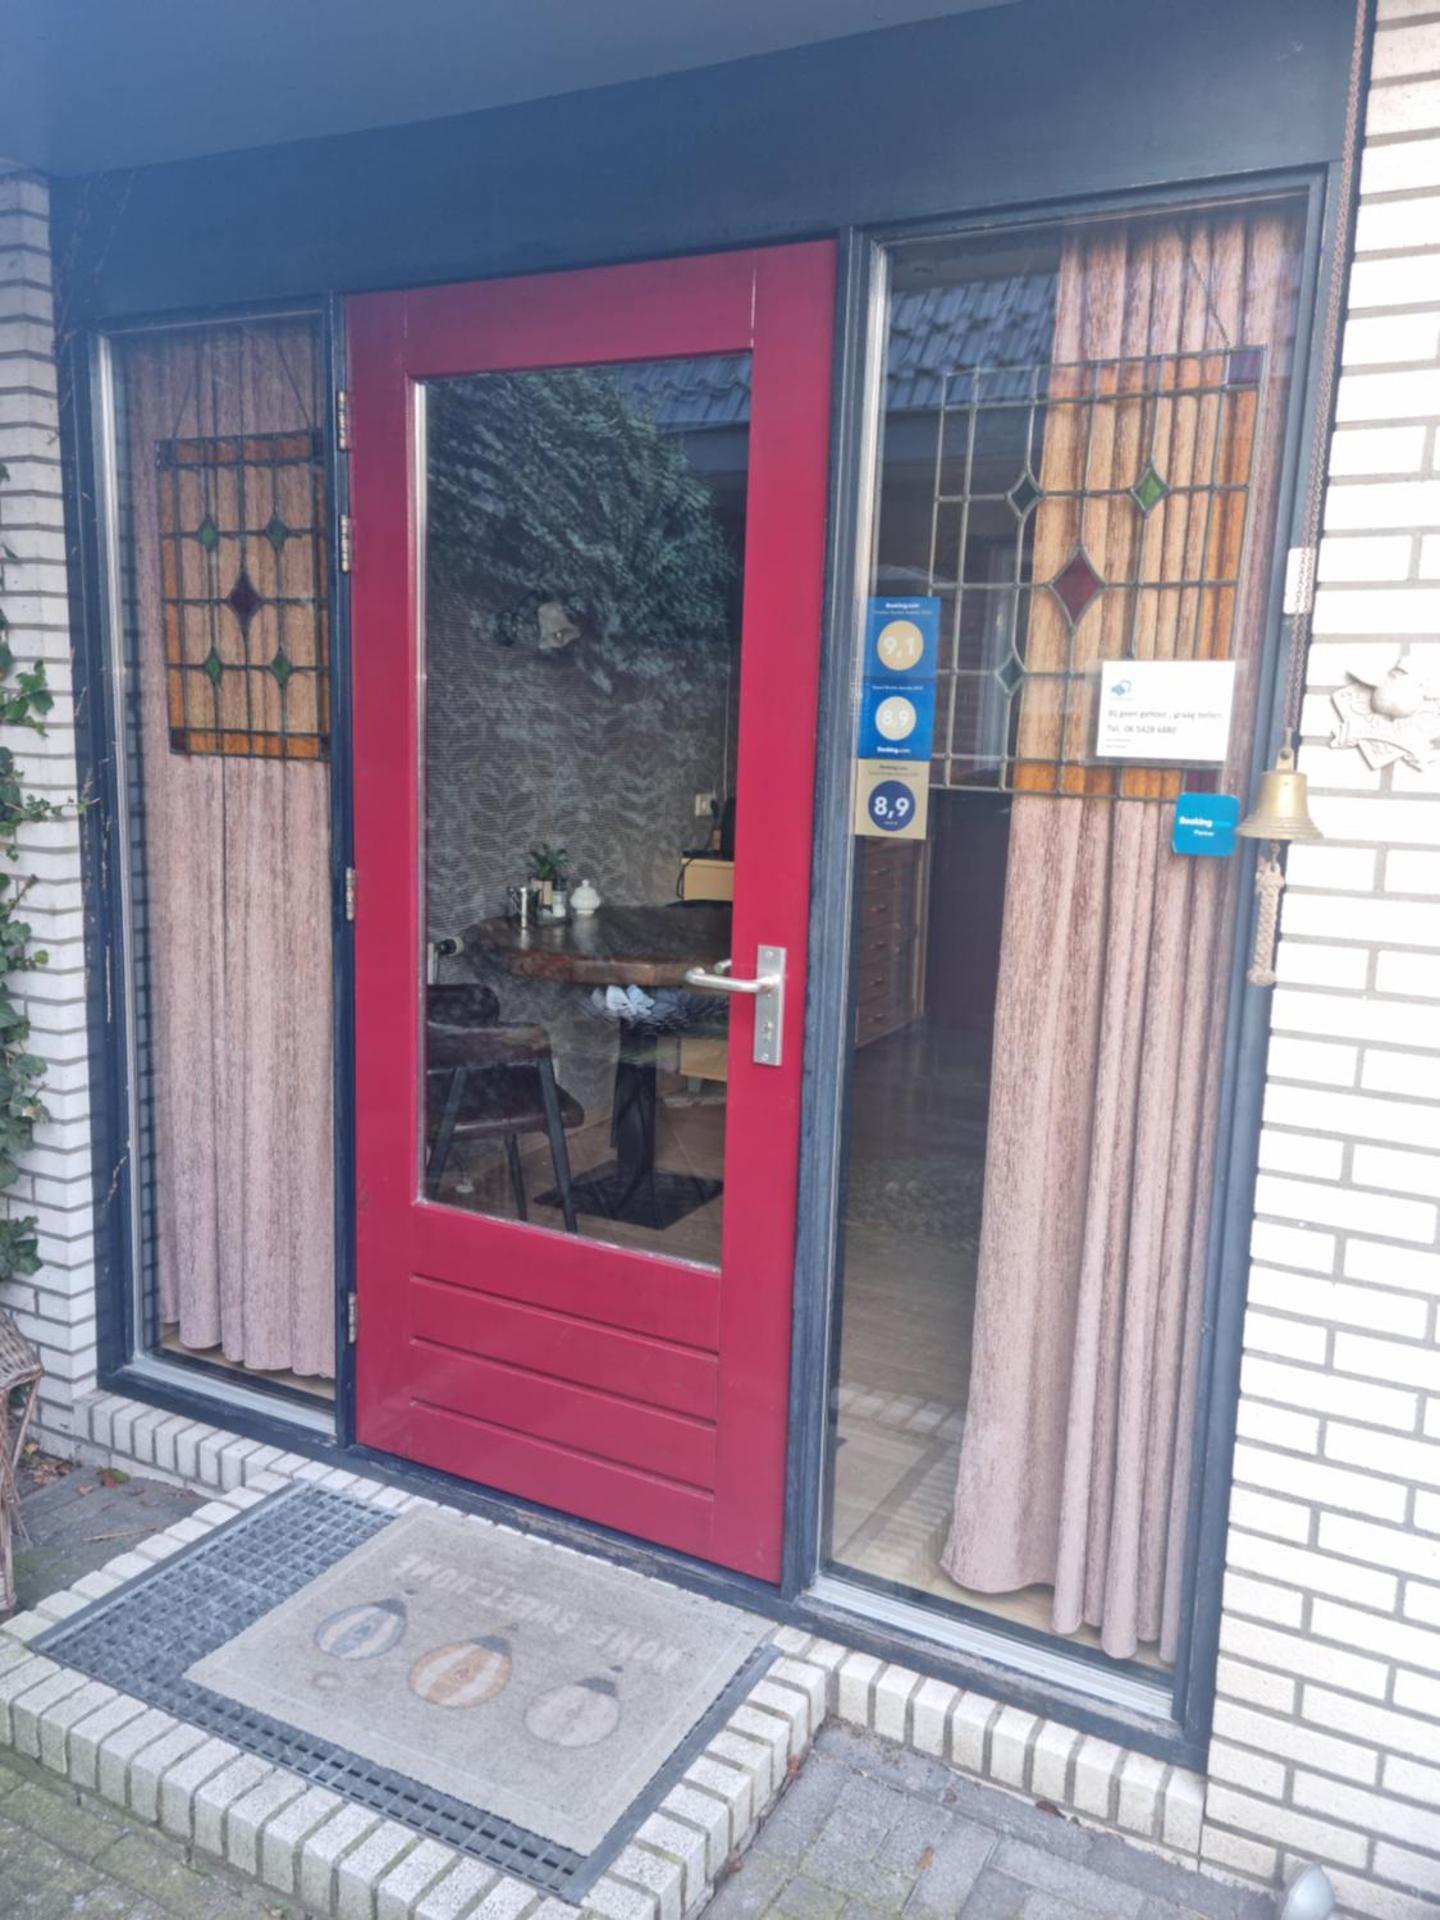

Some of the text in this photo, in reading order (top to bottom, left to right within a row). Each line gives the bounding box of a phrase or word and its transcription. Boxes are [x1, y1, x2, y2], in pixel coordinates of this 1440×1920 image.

[883, 636, 916, 658] 9,1
[880, 709, 910, 729] 8,9
[873, 796, 910, 820] 8,9
[390, 1552, 681, 1676] HOME SWEET HOME
